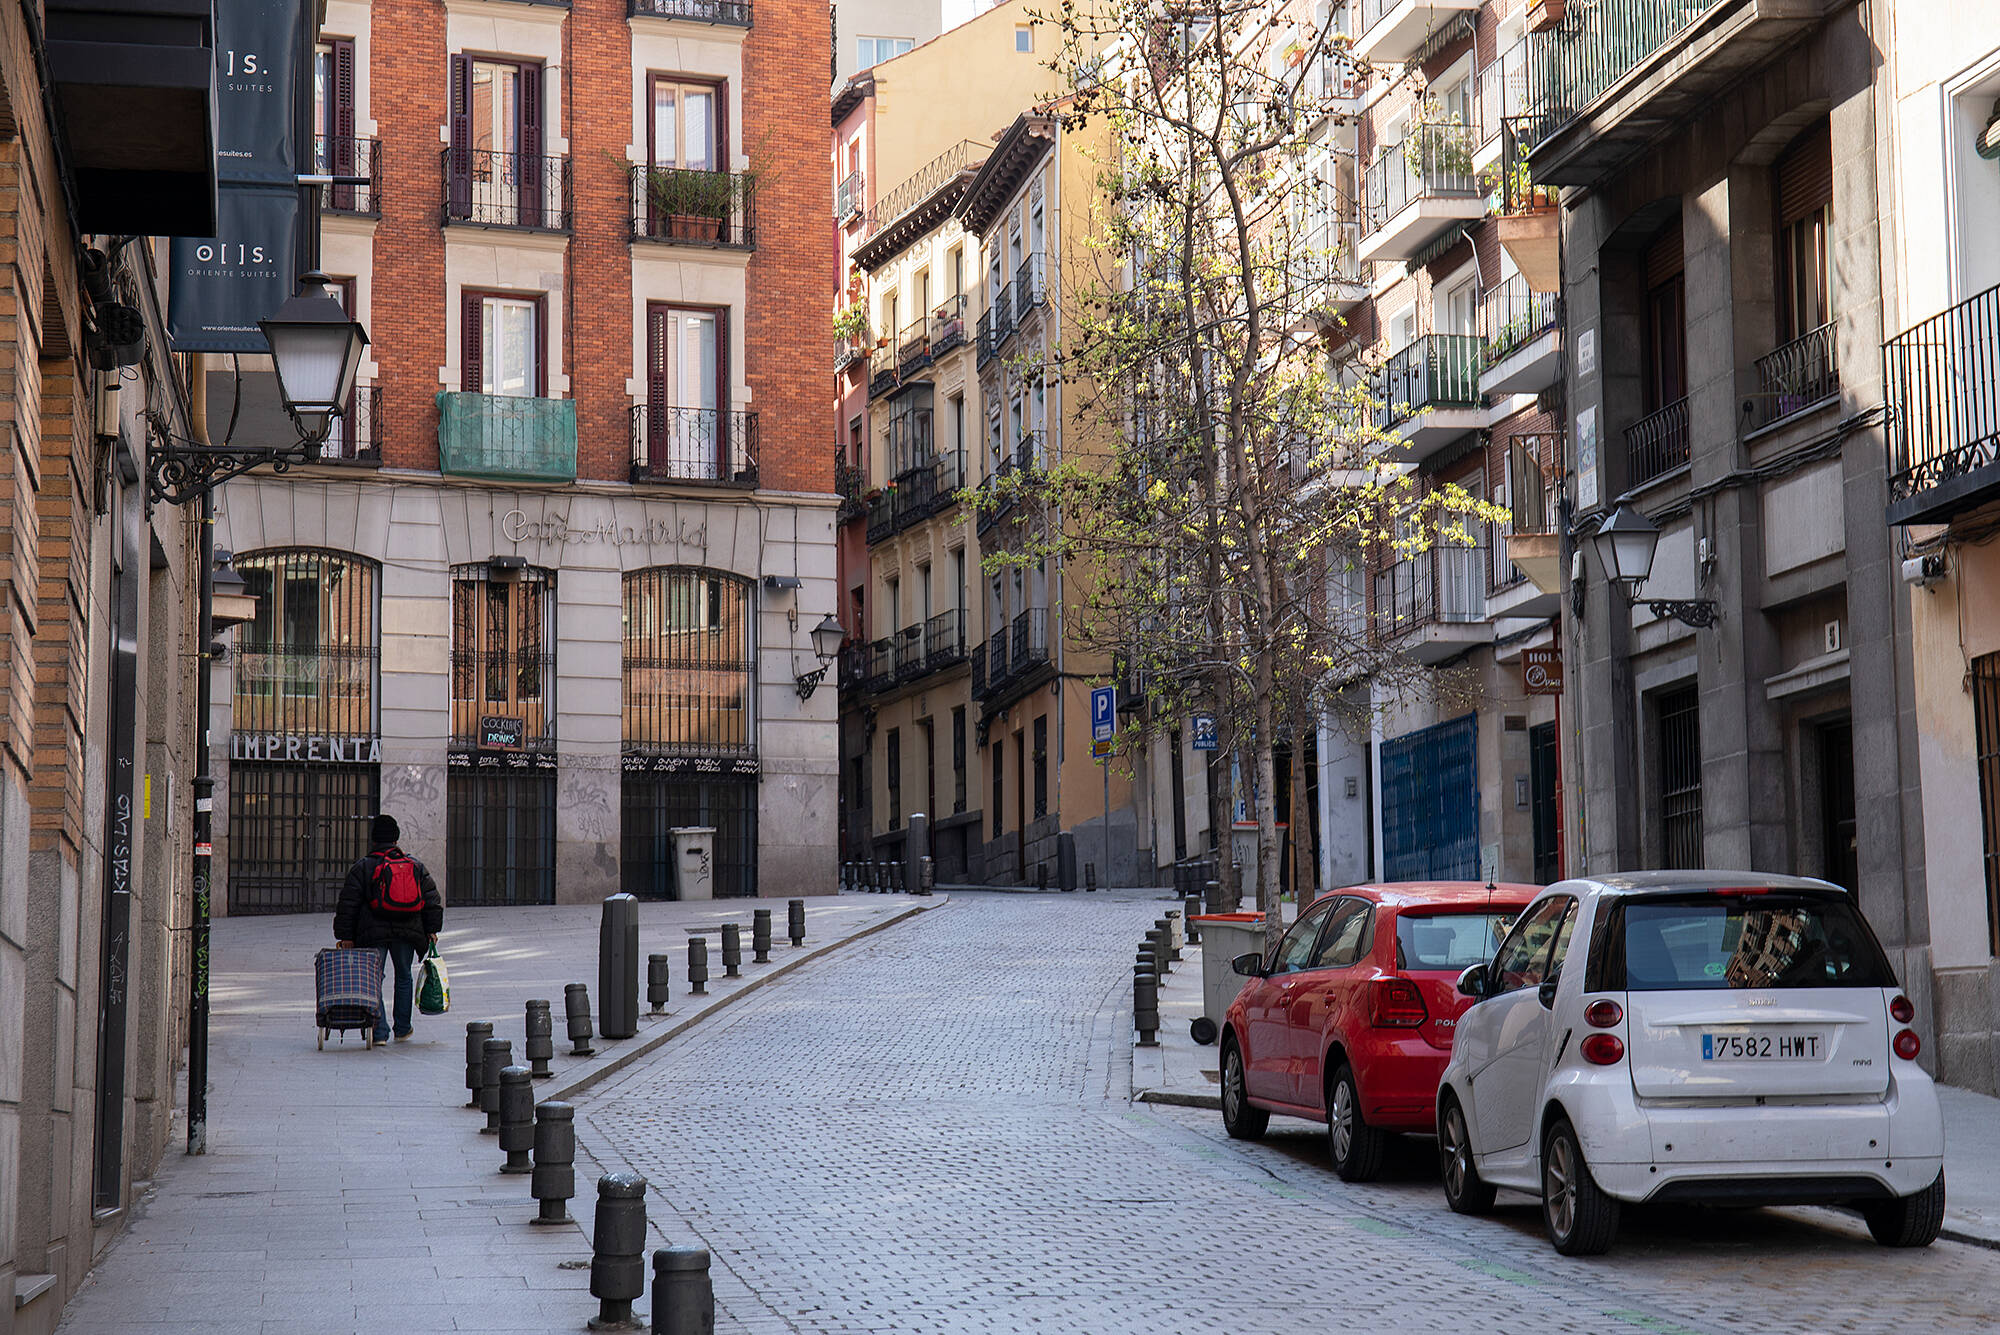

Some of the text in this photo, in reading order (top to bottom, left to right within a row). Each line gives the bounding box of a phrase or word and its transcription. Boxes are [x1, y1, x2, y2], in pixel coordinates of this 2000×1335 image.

[228, 83, 273, 92] SUITES
[217, 150, 253, 158] esuites.es
[187, 269, 234, 277] ORIENTE
[580, 516, 710, 549] Madrid
[1097, 694, 1108, 720] P
[487, 733, 515, 744] DRINKS
[232, 735, 382, 763] IMPRENTA
[1434, 1018, 1457, 1027] POL
[1717, 1036, 1819, 1057] 7582 HWT
